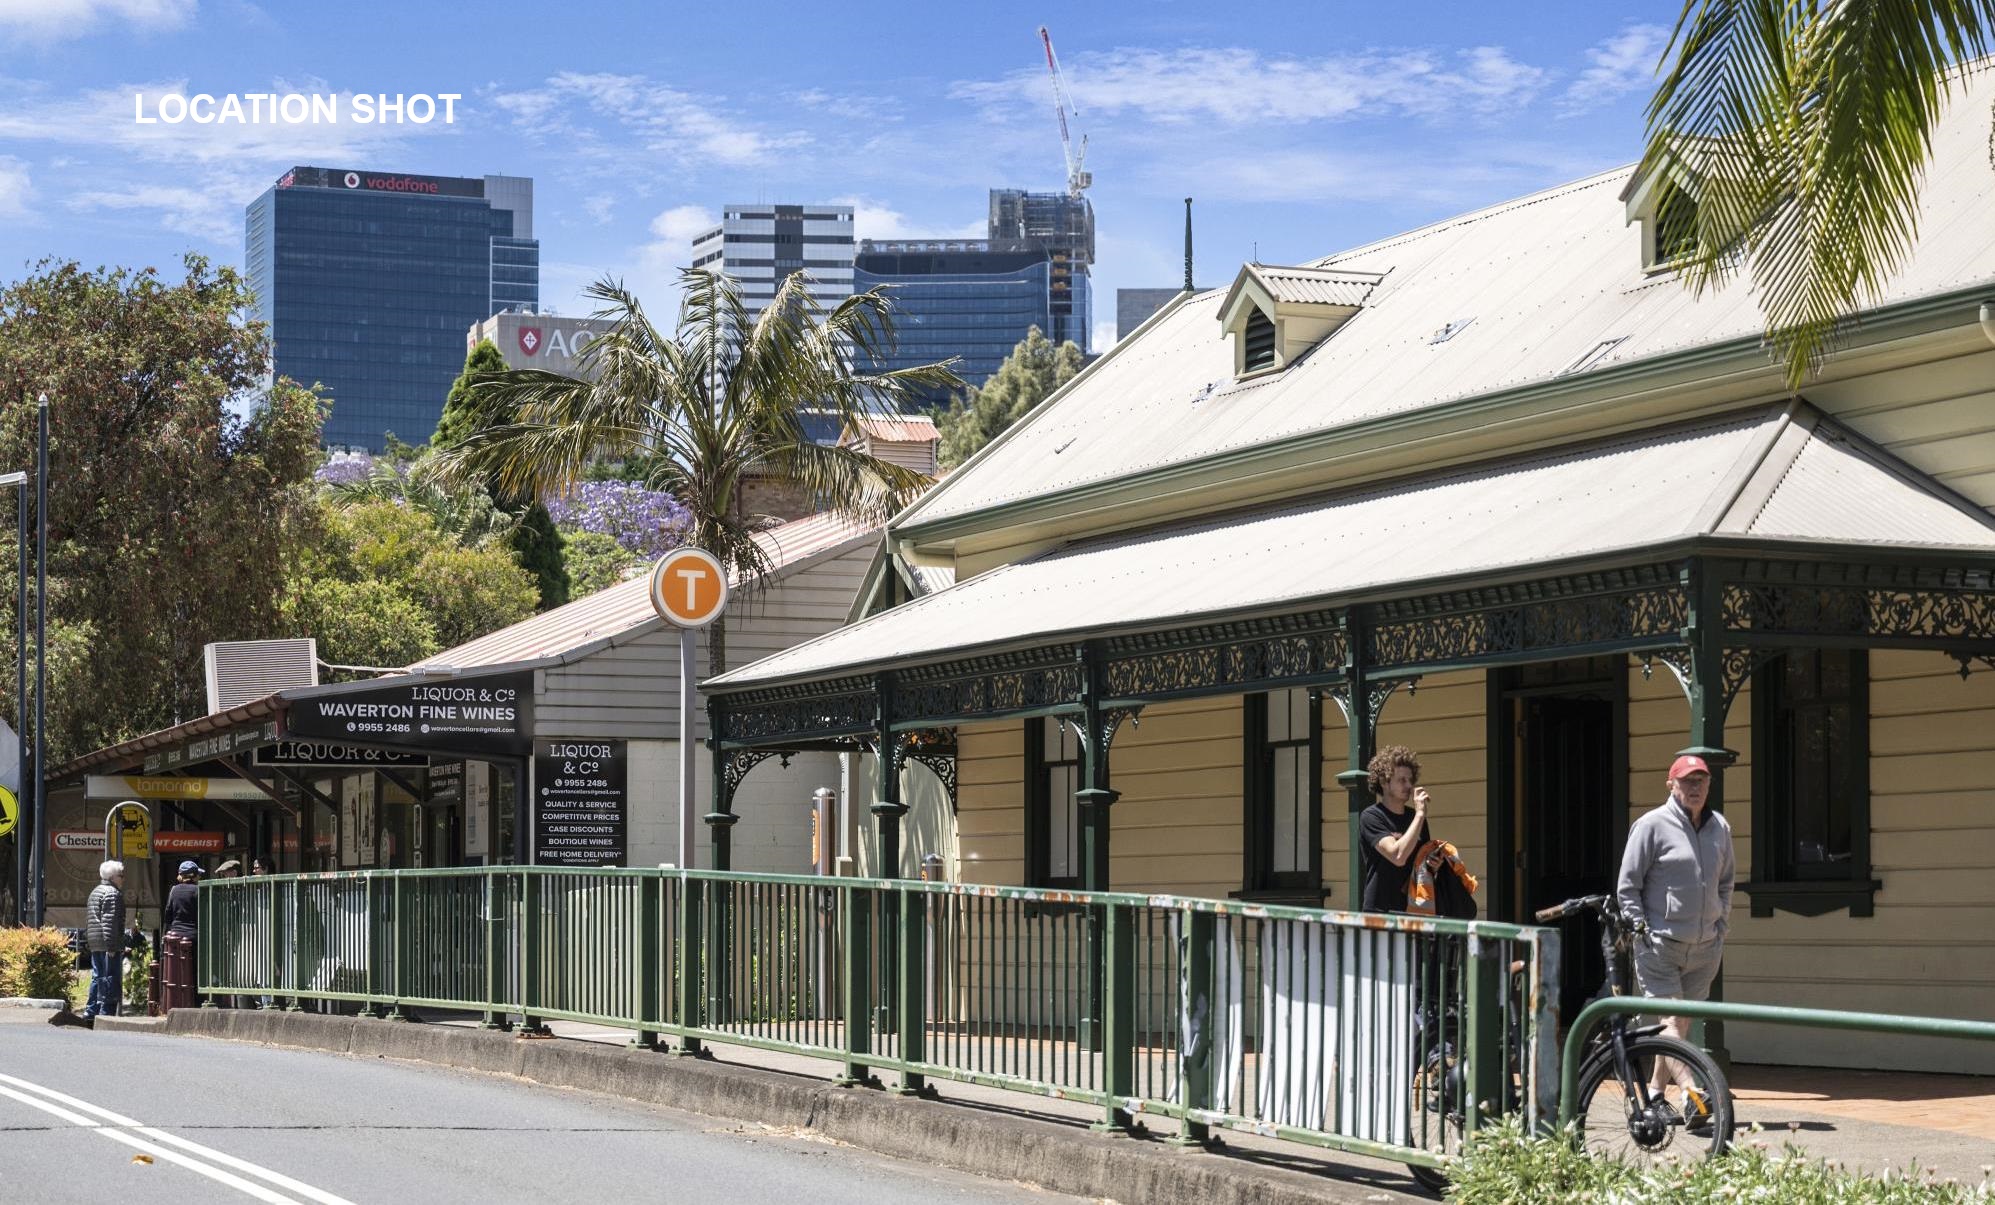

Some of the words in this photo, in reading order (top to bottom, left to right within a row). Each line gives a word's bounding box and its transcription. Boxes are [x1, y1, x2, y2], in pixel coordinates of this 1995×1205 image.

[366, 177, 438, 193] vodafone
[545, 328, 595, 358] AC
[677, 569, 706, 611] T
[411, 687, 476, 702] LIQUOR
[479, 688, 492, 702] &
[318, 702, 413, 718] WAVERTON
[420, 706, 457, 719] FINE
[462, 706, 515, 720] WINES
[358, 723, 384, 732] 9955
[386, 724, 410, 732] 2486
[274, 742, 360, 761] LIQUOR
[550, 745, 612, 758] LIQUOR
[564, 761, 576, 774] &
[137, 778, 202, 793] tamarind
[545, 800, 577, 808] QUALITY
